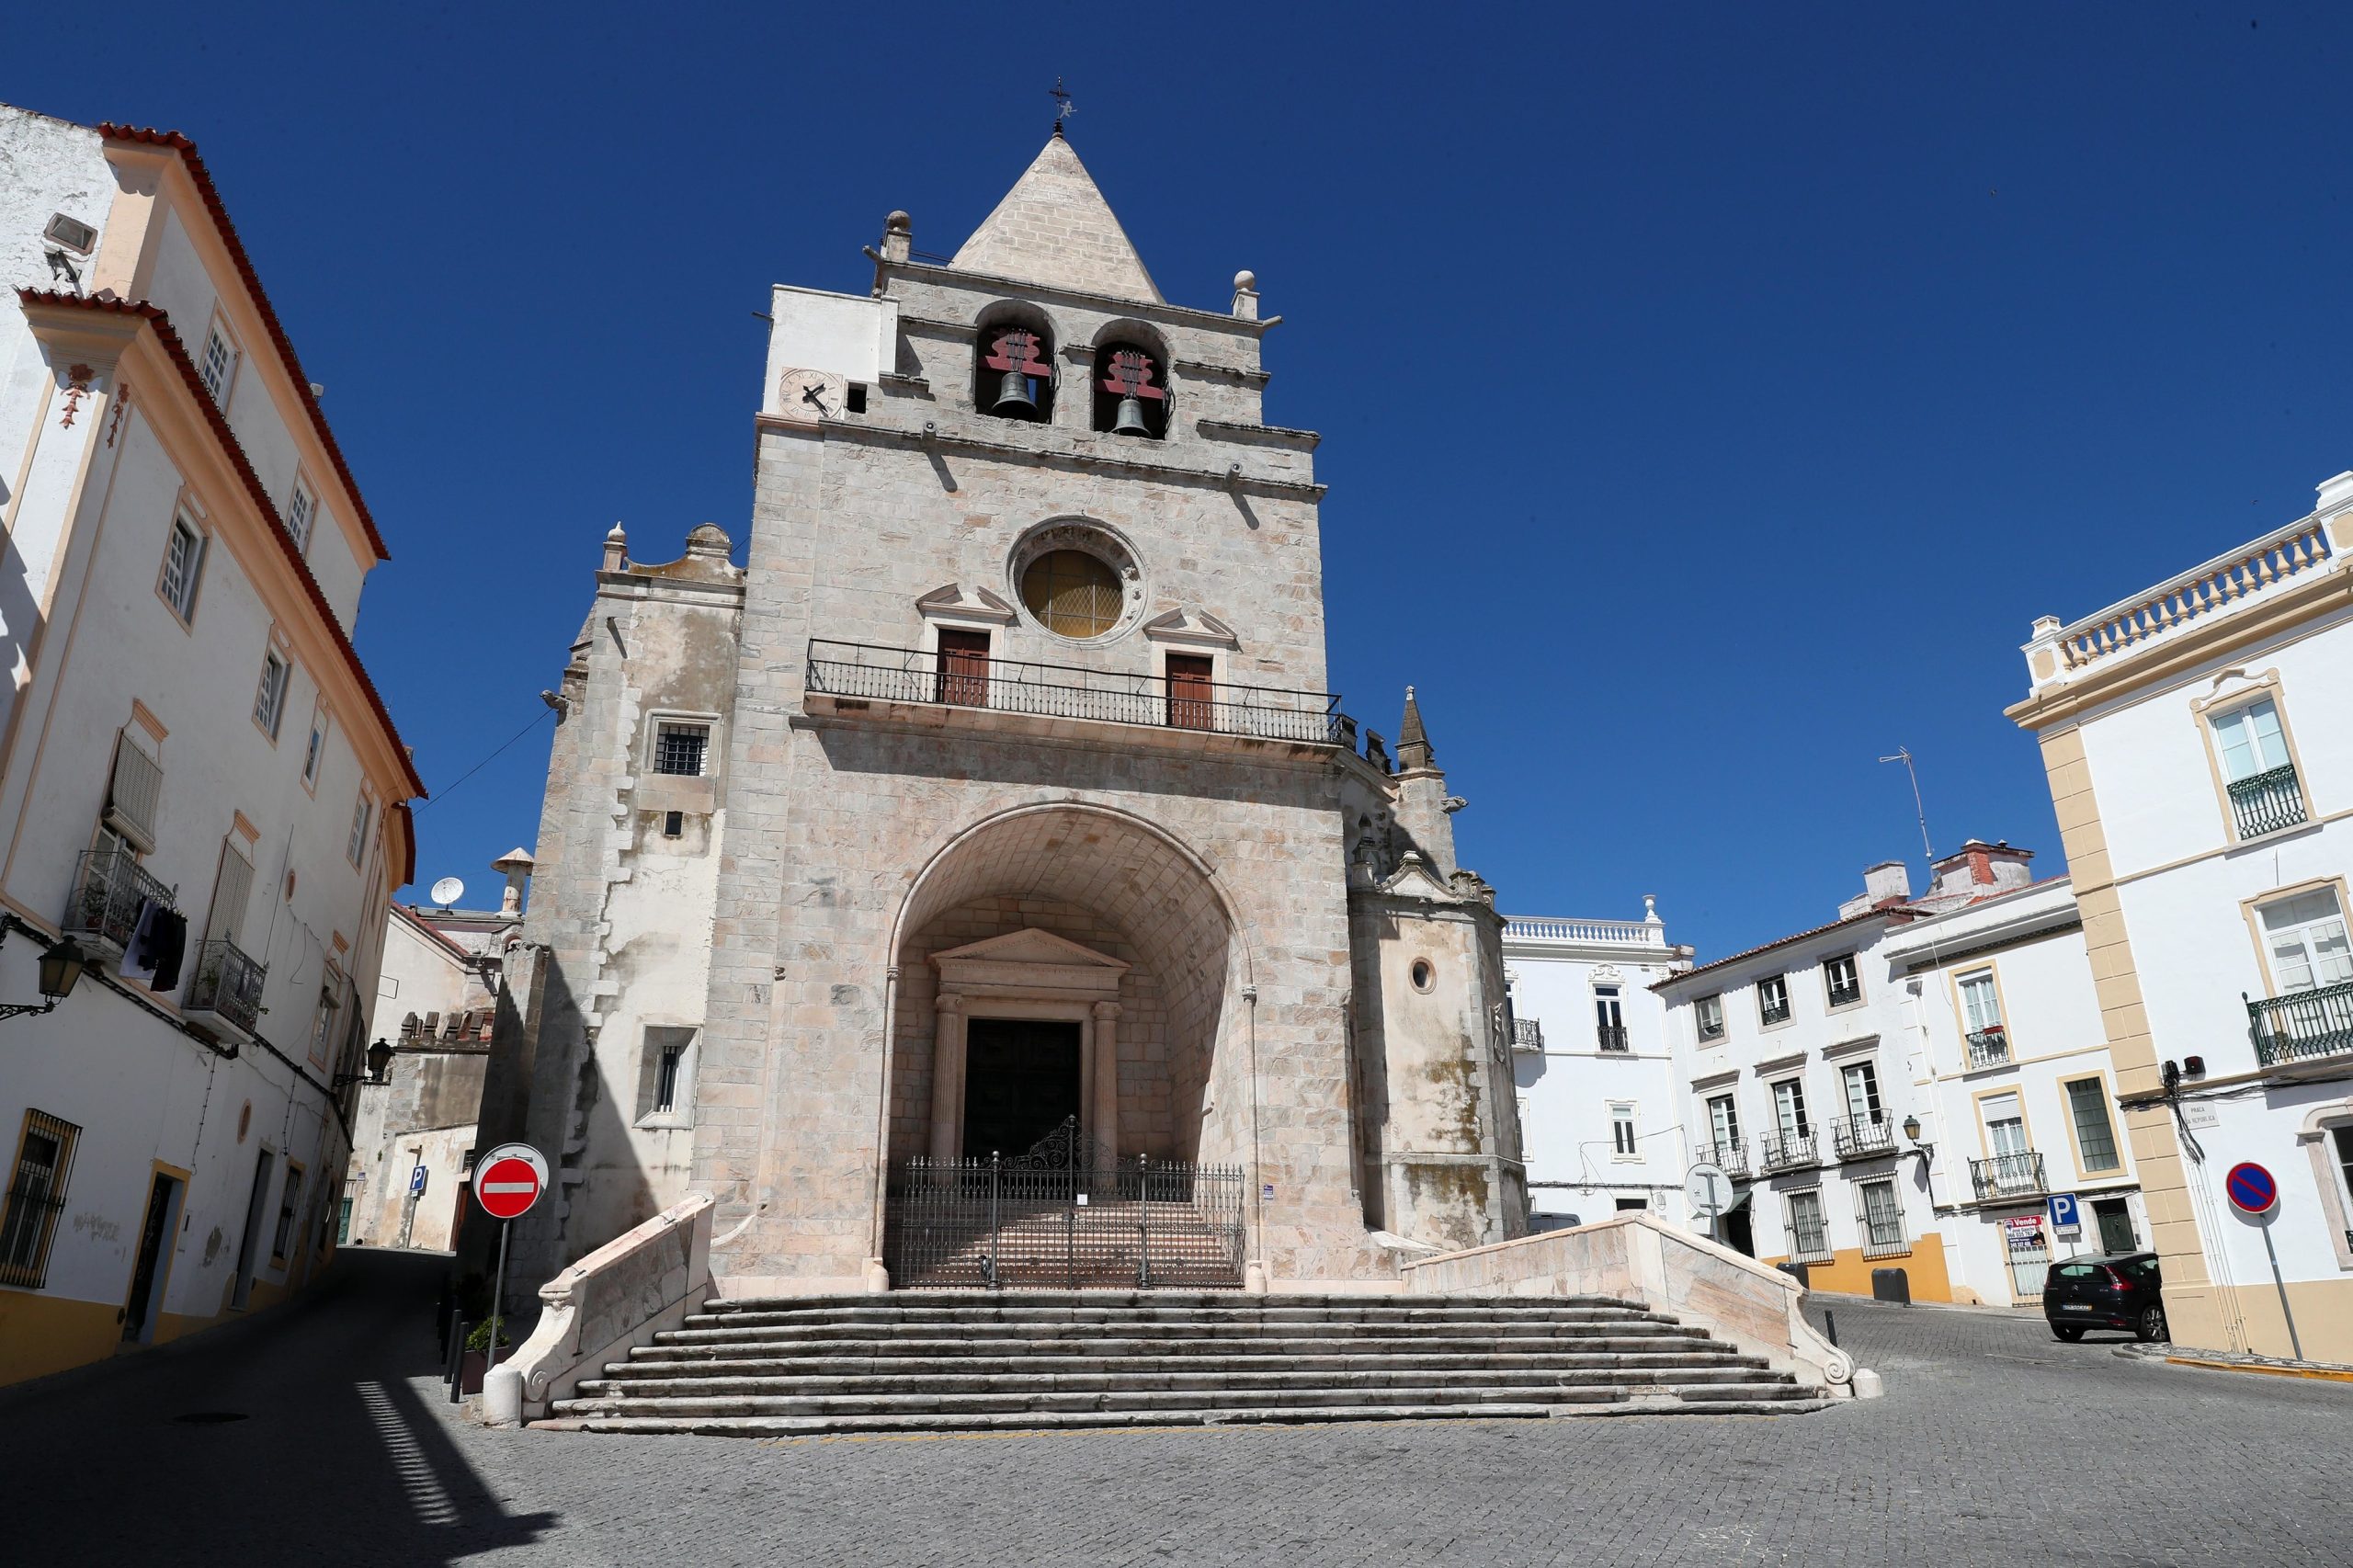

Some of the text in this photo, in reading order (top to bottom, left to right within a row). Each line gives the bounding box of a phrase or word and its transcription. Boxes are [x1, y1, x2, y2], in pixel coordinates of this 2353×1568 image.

[412, 1167, 423, 1188] P
[2052, 1198, 2071, 1223] P
[2014, 1218, 2037, 1226] Vende
